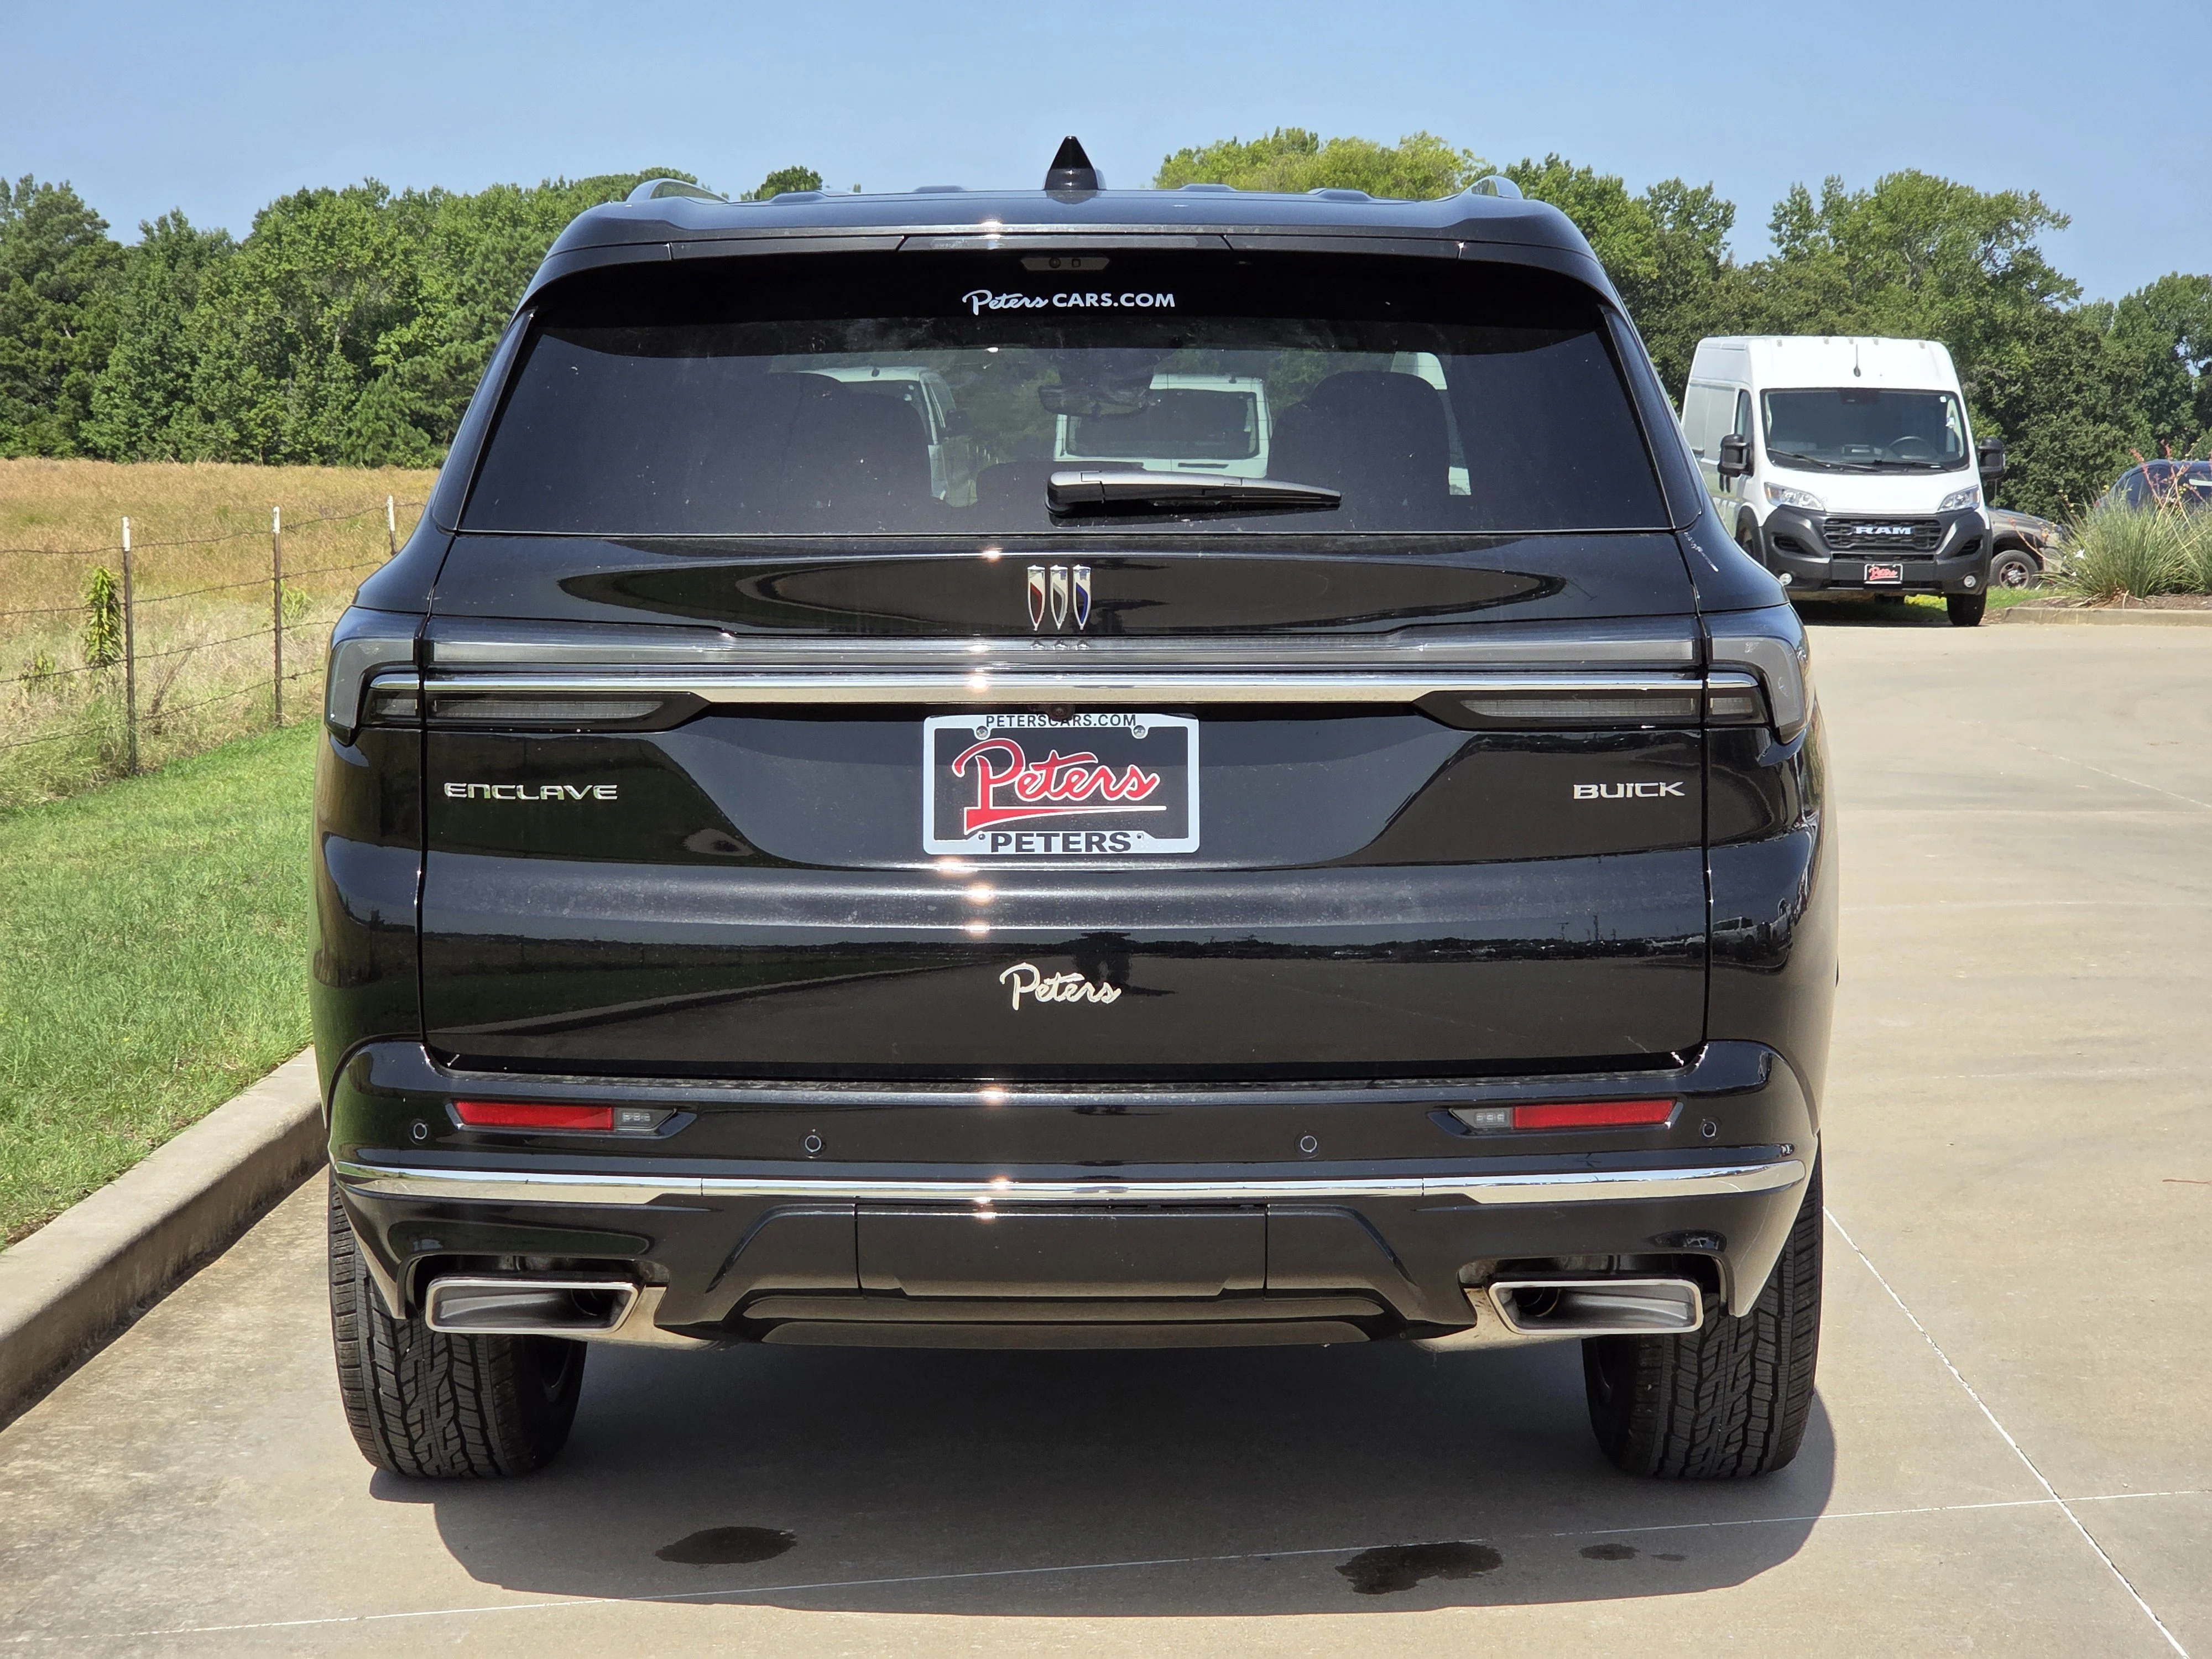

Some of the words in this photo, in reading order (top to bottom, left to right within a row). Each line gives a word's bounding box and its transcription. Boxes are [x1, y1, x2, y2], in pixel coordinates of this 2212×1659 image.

[1856, 526, 1911, 535] RAM
[444, 783, 618, 800] ENCLAVE
[952, 738, 1161, 835] Peters
[1573, 781, 1686, 799] BUICK
[991, 832, 1131, 853] PETERS
[999, 962, 1121, 1011] Peters
